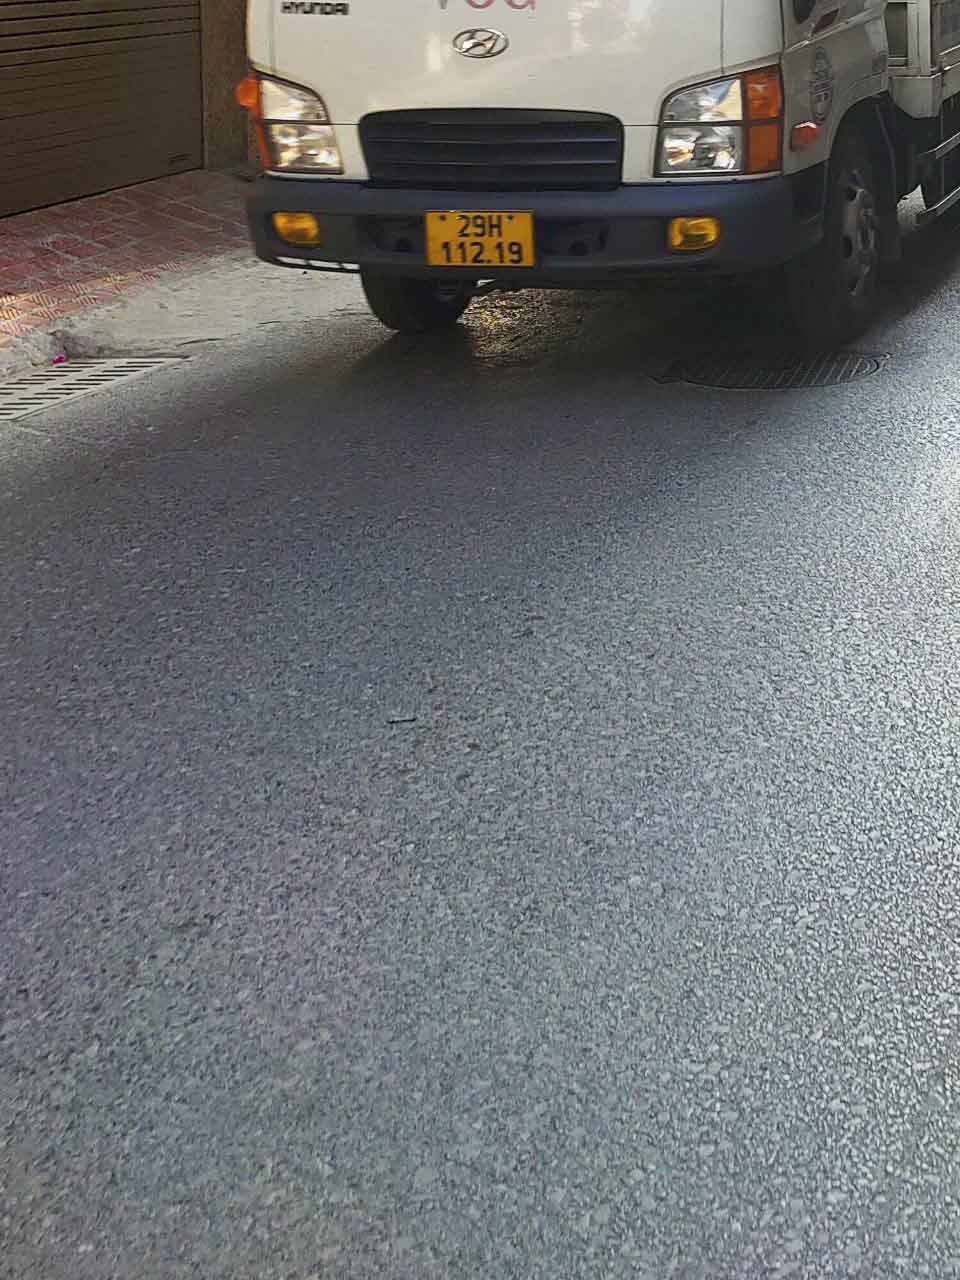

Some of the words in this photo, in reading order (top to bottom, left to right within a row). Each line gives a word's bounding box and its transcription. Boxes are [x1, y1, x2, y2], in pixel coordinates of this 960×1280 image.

[280, 1, 350, 16] HYUNDAI
[456, 214, 503, 238] 29H
[442, 240, 524, 265] 112.19
